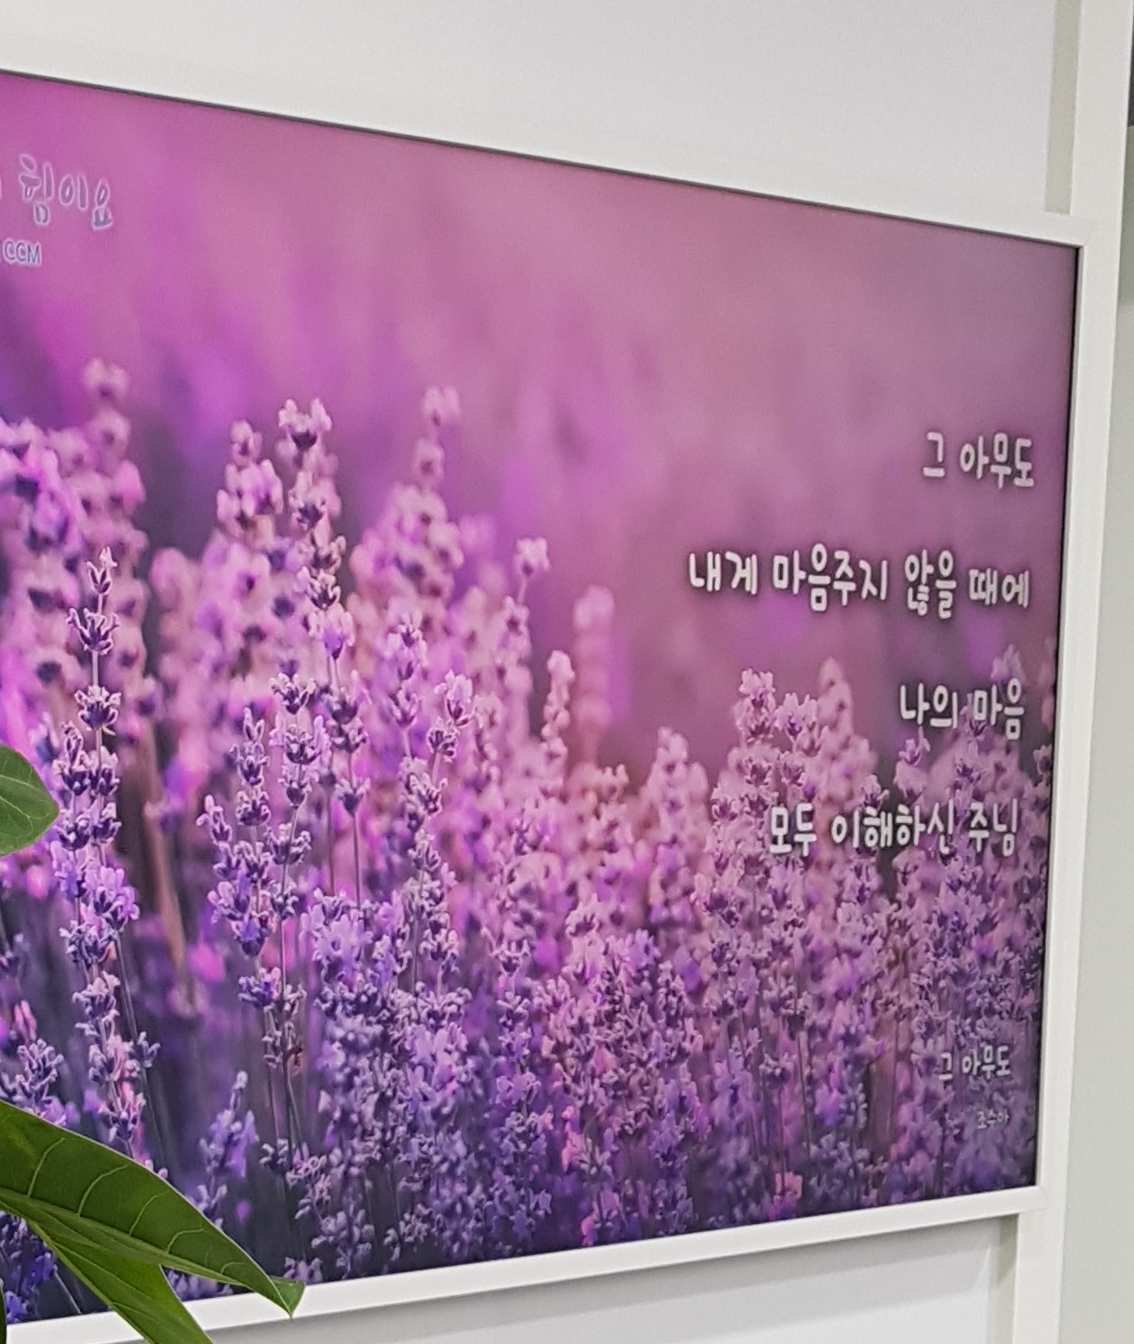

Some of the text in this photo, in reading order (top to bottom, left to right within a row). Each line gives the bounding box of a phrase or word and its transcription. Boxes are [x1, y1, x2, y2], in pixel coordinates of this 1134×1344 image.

[19, 152, 113, 230] 힘이요
[3, 240, 42, 266] CCM
[922, 431, 1035, 489] 그 아무도
[689, 543, 1030, 620] 내게 마음주지 않을 때에
[900, 677, 1025, 741] 나의 마음
[769, 798, 1018, 857] 모두 이해하신 주님
[938, 1044, 1012, 1081] 그 아무도
